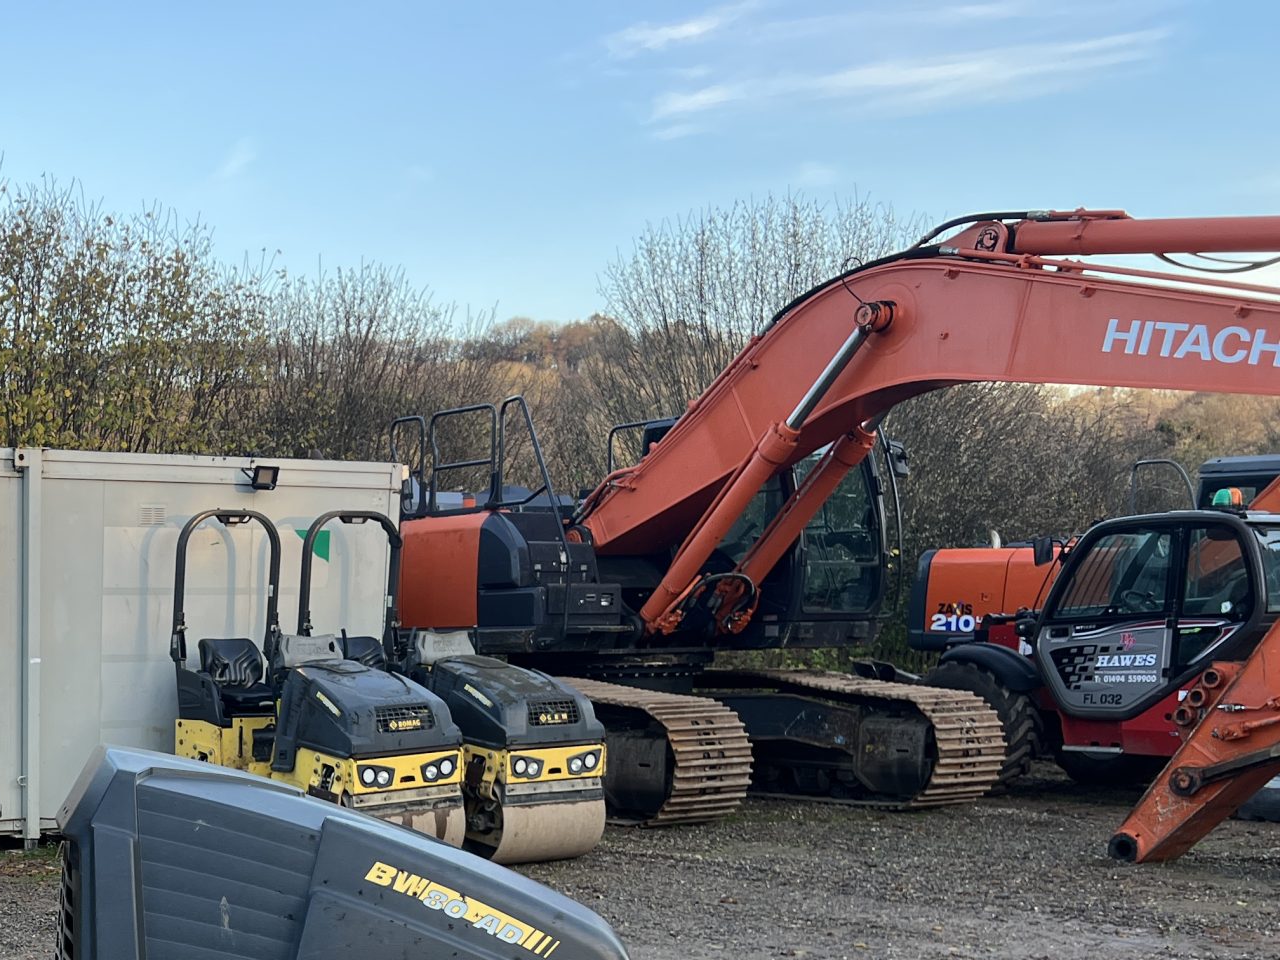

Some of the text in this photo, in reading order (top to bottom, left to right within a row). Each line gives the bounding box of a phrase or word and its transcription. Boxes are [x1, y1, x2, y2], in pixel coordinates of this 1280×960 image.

[938, 602, 973, 615] ZAXIS
[1095, 654, 1157, 667] HAWES
[1103, 675, 1125, 683] 01494
[1128, 674, 1157, 683] 559900
[1083, 694, 1122, 704] FL 032
